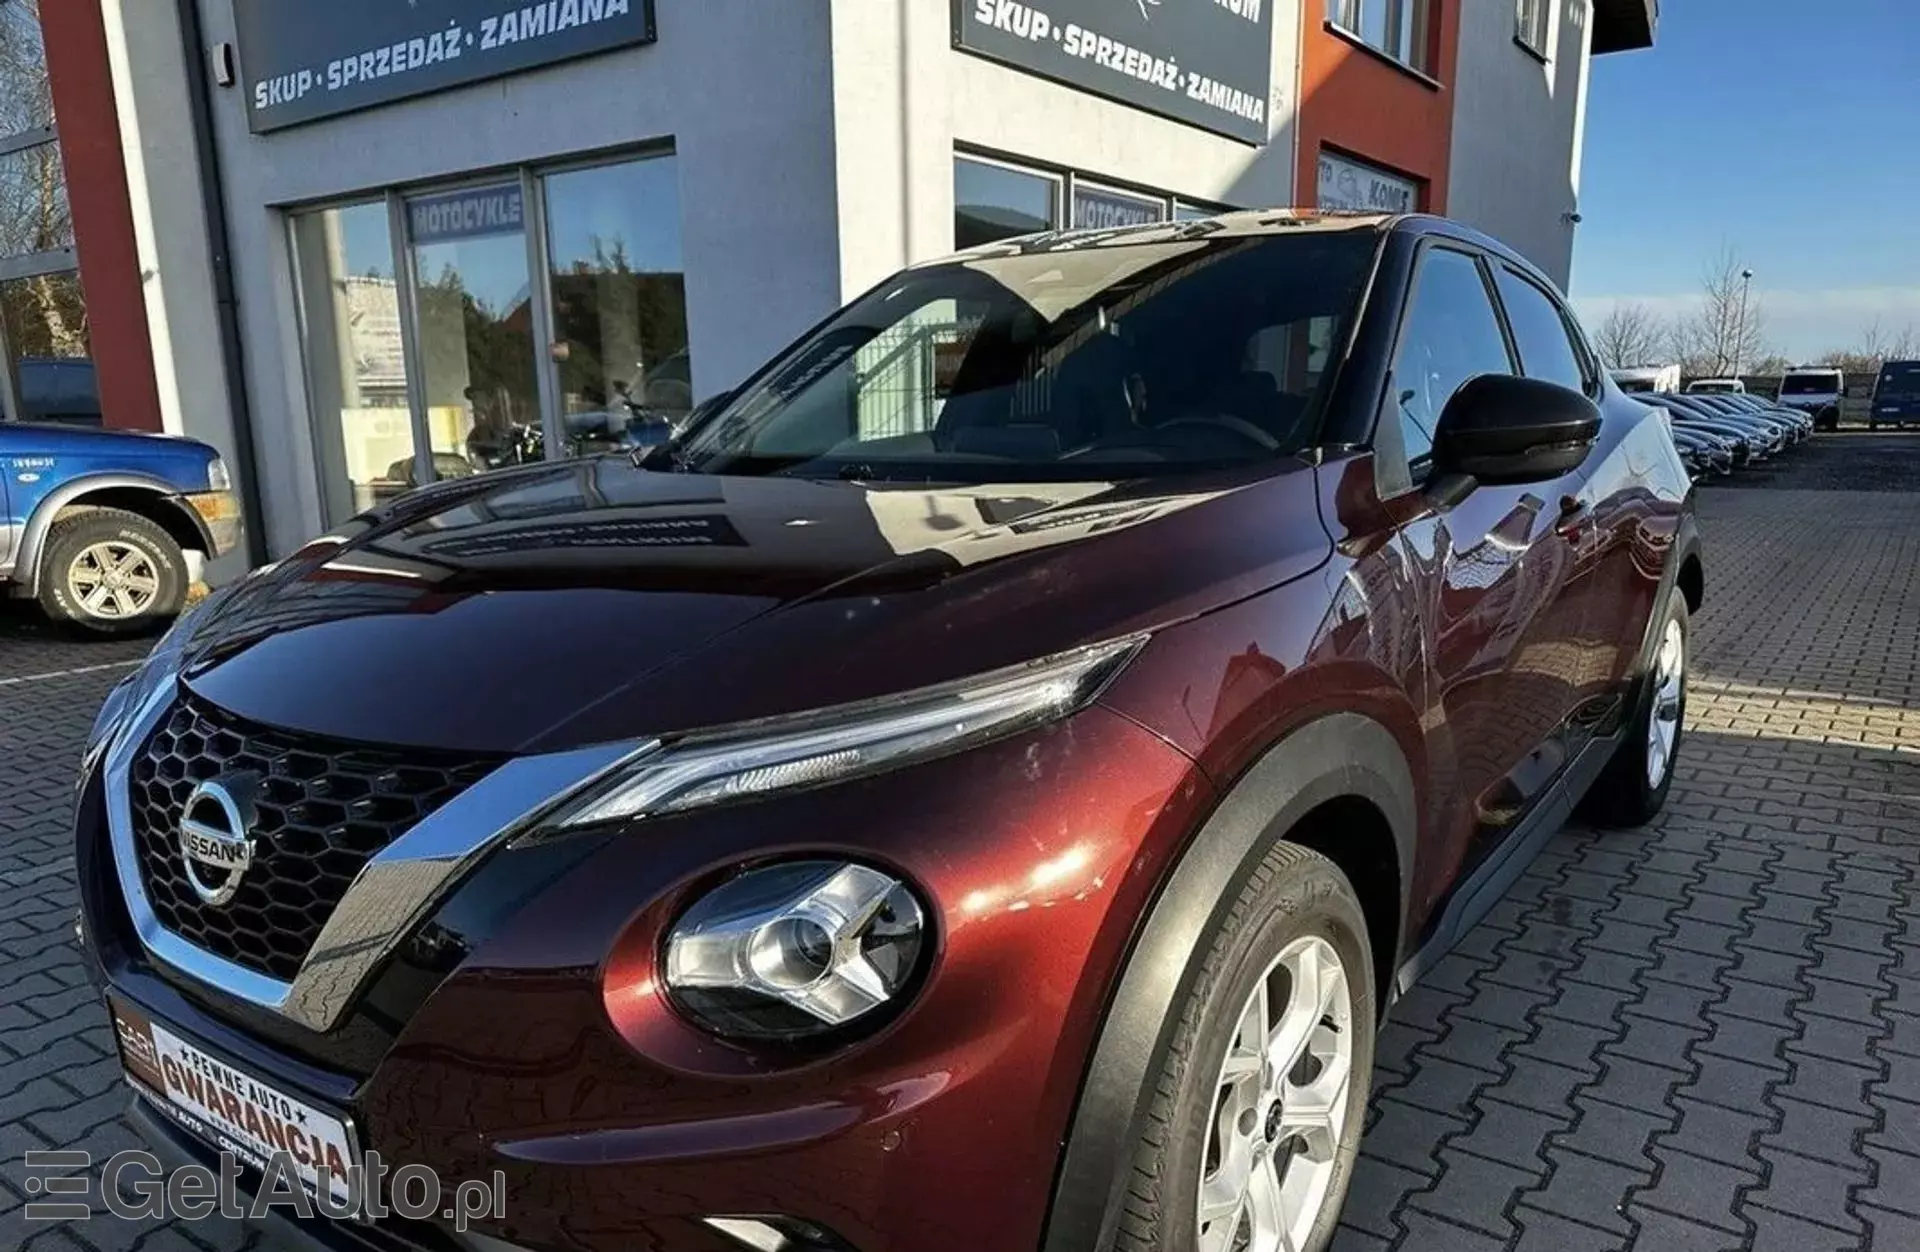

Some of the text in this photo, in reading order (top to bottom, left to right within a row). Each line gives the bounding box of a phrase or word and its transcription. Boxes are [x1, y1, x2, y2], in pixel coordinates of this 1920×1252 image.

[255, 70, 312, 109] SKUP
[327, 21, 461, 90] SPRZEDAŻ
[974, 0, 1264, 123] SKUP SPRZEDAŻ ZAMIANA
[413, 195, 521, 234] MOTOCYKLE
[181, 830, 235, 863] NISSAN
[161, 1053, 349, 1185] GWARANCJA
[191, 1051, 245, 1096] PEWNE
[249, 1083, 292, 1121] AUTO
